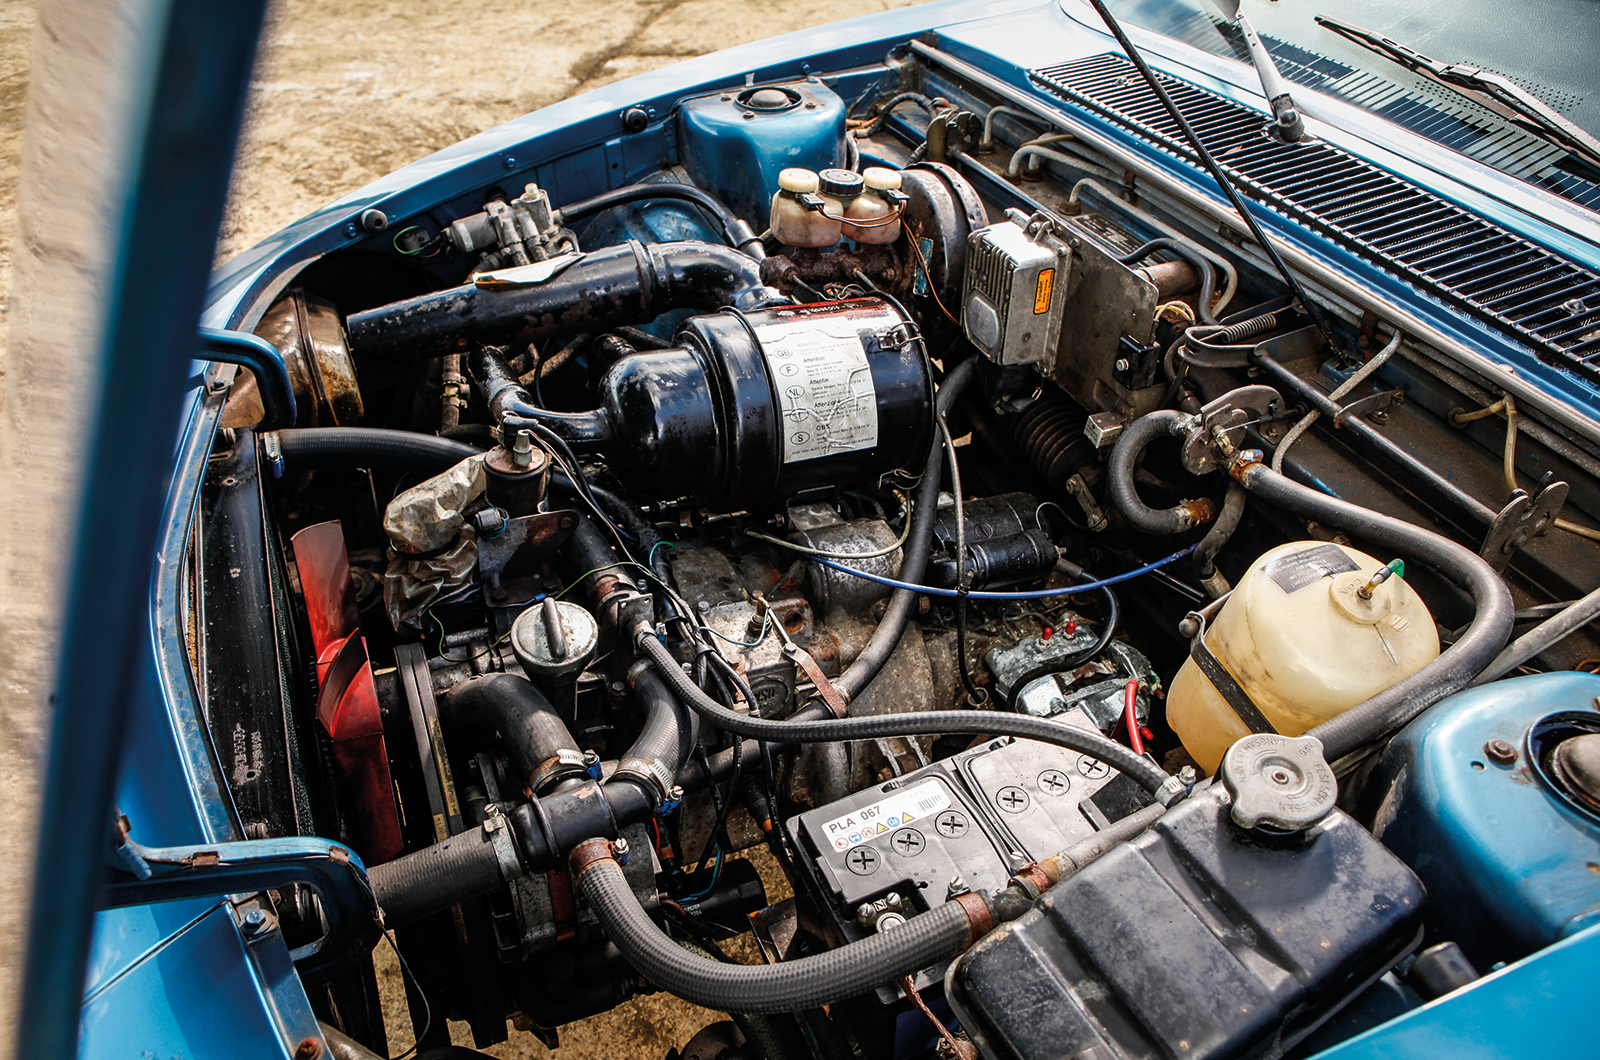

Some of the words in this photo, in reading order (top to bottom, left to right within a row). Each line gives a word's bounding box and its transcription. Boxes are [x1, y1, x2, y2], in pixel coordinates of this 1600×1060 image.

[803, 356, 826, 364] Attention
[788, 389, 801, 397] NL
[1242, 737, 1287, 751] LANGSAM
[1299, 742, 1314, 757] AKG
[829, 818, 856, 833] PLA
[860, 805, 881, 821] 067
